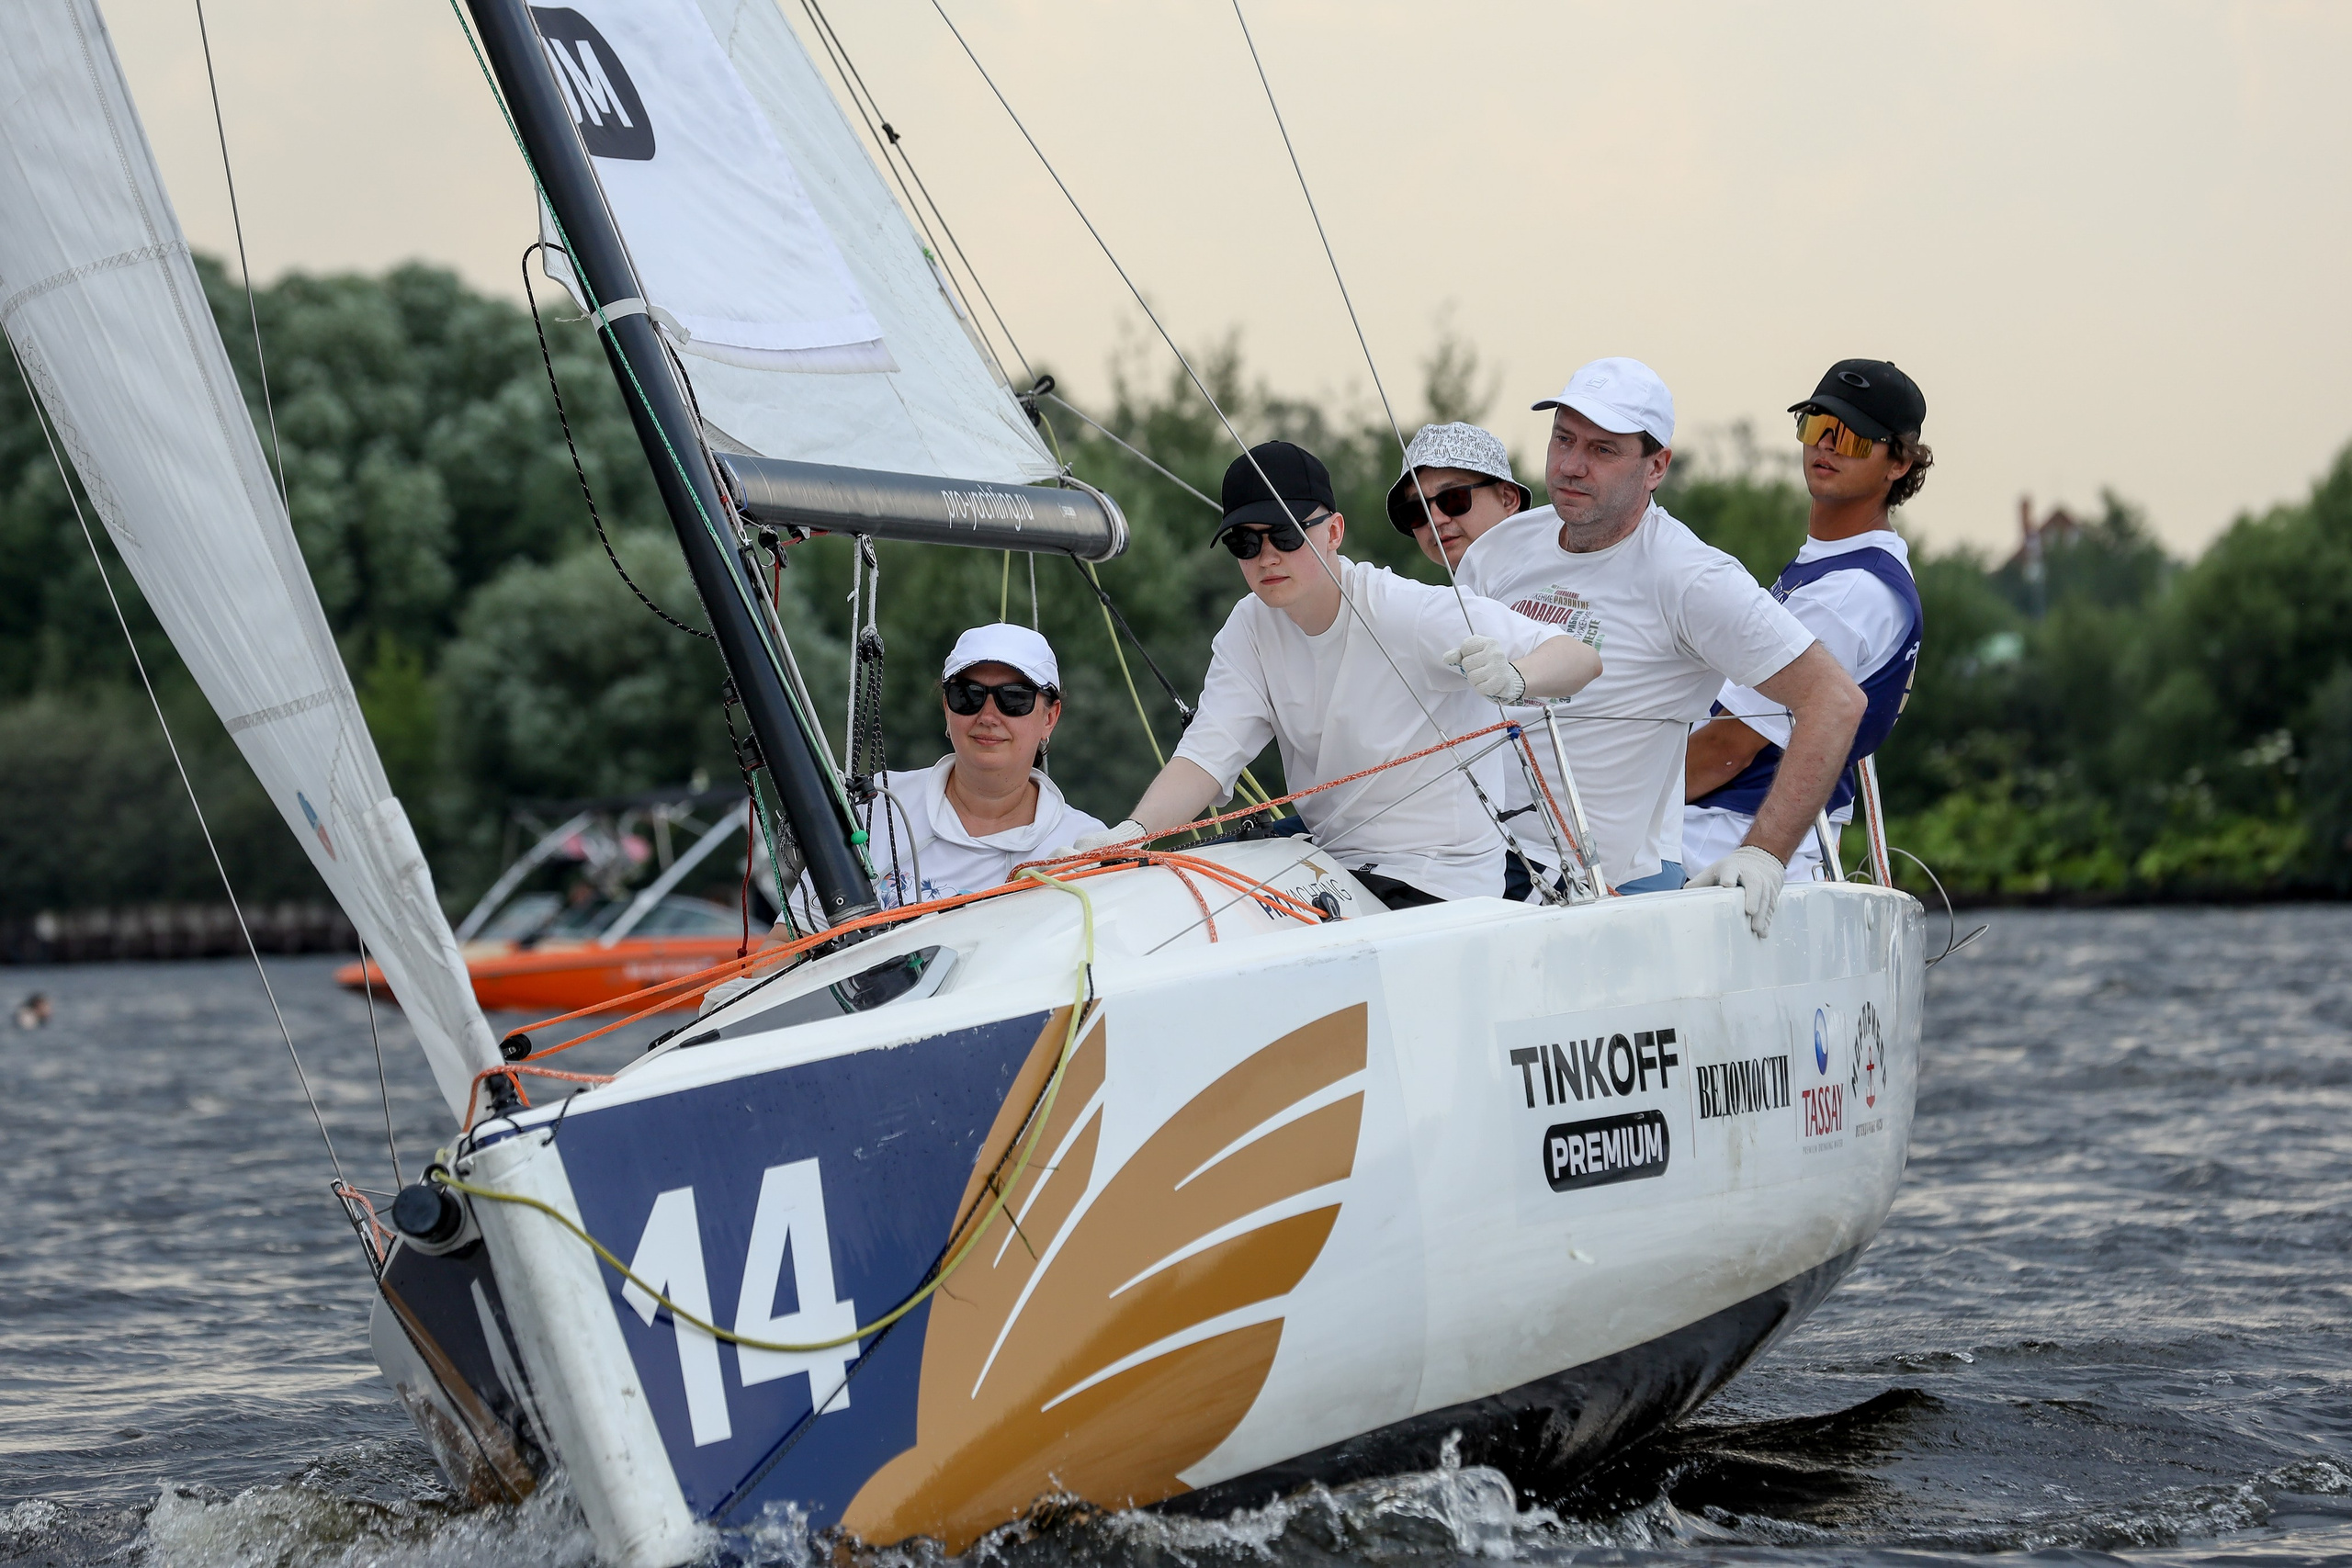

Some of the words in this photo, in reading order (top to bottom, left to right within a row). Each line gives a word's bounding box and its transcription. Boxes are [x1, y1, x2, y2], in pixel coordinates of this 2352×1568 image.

[940, 484, 1035, 532] pro-yachting.ru
[1554, 595, 1590, 610] РАЗВИТИЕ
[1567, 610, 1585, 633] РАБОТА
[1510, 1028, 1679, 1108] TINKOFF
[1696, 1055, 1791, 1124] ВЕДОМОСТИ
[1802, 1083, 1843, 1137] TASSAY
[1550, 1122, 1664, 1179] PREMIUM
[622, 1156, 860, 1448] 14
